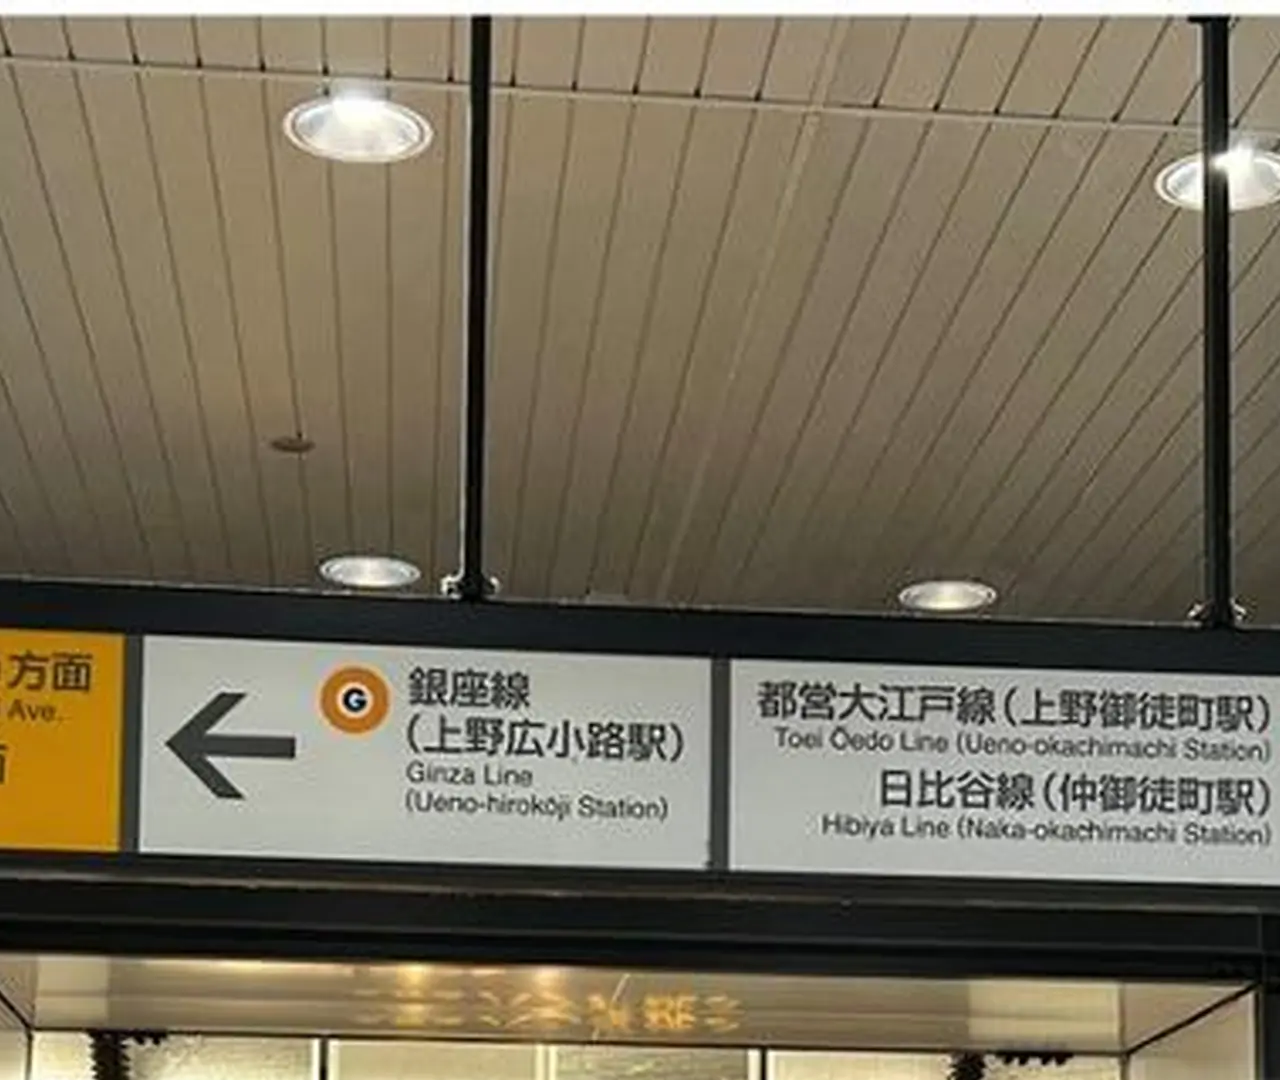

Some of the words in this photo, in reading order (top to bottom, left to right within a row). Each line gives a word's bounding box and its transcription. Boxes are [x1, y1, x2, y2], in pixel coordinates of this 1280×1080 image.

[344, 688, 366, 711] G
[408, 668, 531, 709] 銀座線
[7, 699, 63, 724] Ave.
[757, 681, 1273, 732] 都営大江戸線(上野御徒町駅)
[406, 718, 686, 763] (上野広小路駅)
[775, 727, 823, 749] Toei
[900, 730, 951, 755] Line
[956, 732, 1177, 762] (Ueno-okachimachi
[1184, 737, 1273, 764] Station)
[407, 762, 478, 785] Ginza
[483, 763, 533, 787] Line
[577, 795, 669, 821] Station)
[879, 770, 1274, 816] 日比谷線(仲御徒町駅)
[821, 815, 895, 842] Hibiya
[901, 816, 951, 840] Line
[956, 817, 1177, 846] (Naka-okachimachi
[1183, 820, 1273, 848] Station)
